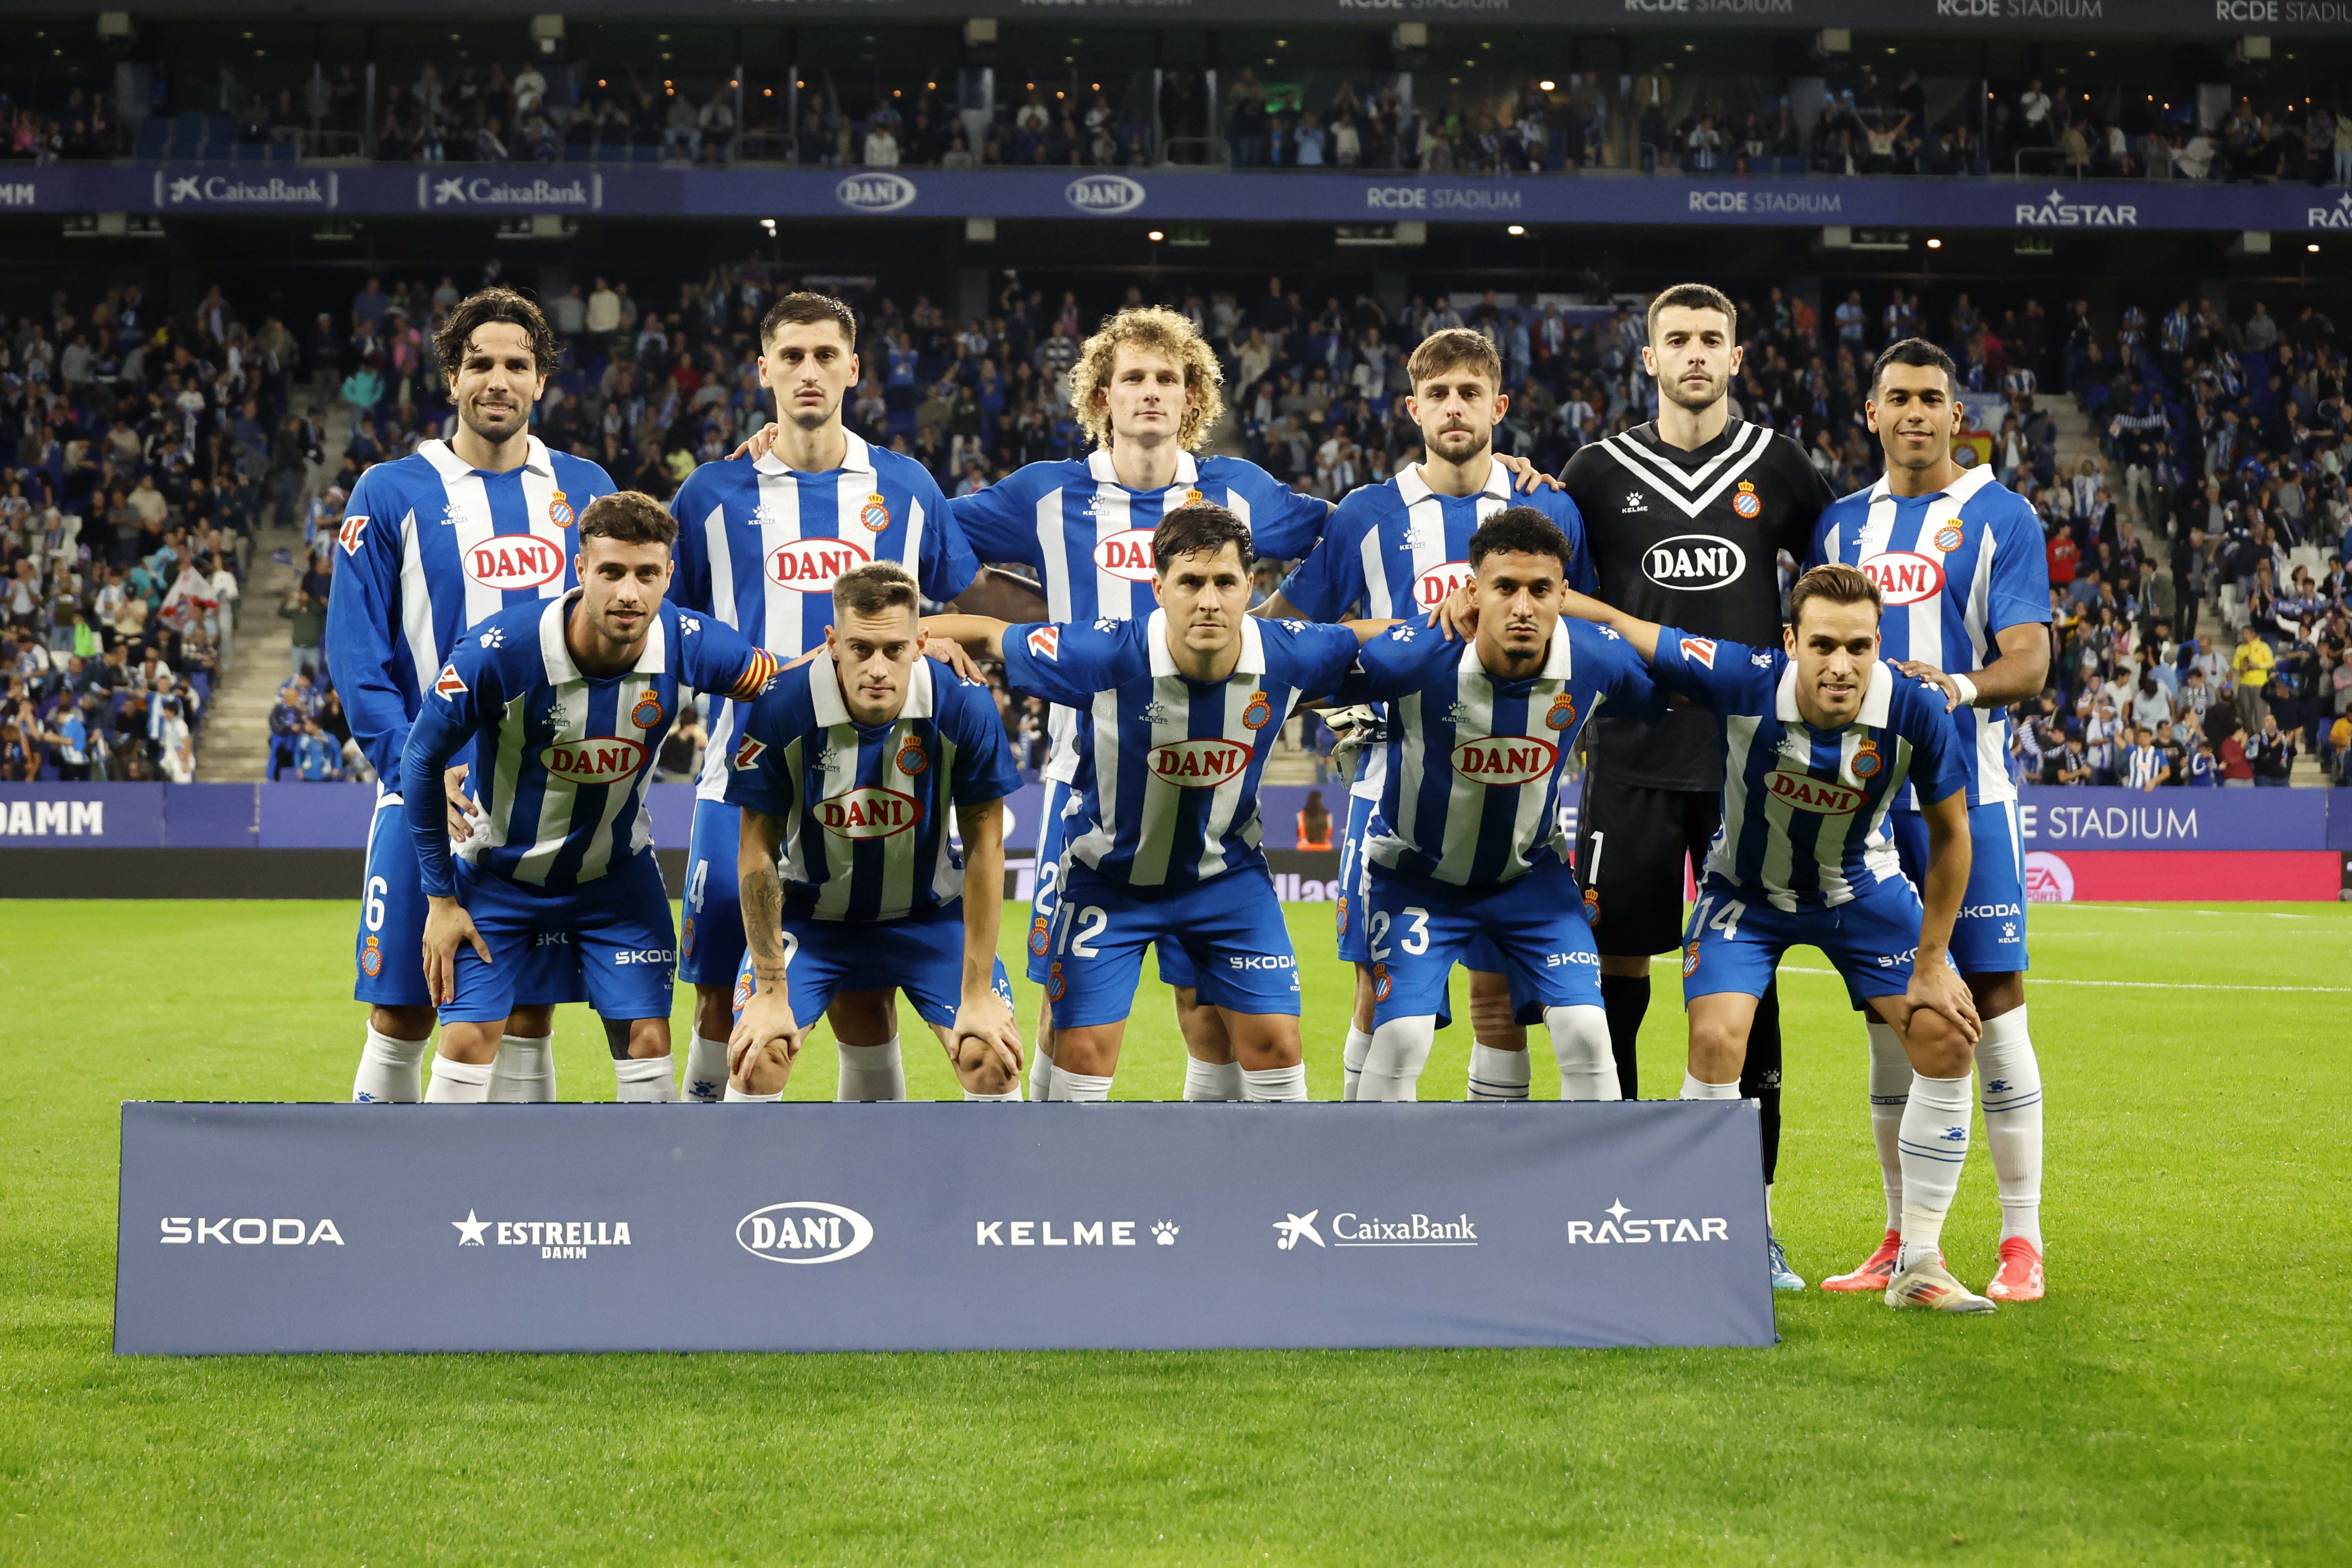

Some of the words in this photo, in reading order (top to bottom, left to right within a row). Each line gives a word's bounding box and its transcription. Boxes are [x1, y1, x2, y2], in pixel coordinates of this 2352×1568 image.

[1937, 0, 2000, 17] RCDE
[2007, 0, 2102, 17] STADIUM
[2216, 0, 2278, 21] RCDE
[204, 177, 322, 202] CaixaBank
[469, 178, 586, 204] CaixaBank
[846, 181, 898, 203] DANI
[1075, 184, 1128, 205] DANI
[1367, 188, 1426, 208] RCDE
[1432, 189, 1521, 210] STADIUM
[1689, 191, 1747, 212] RCDE
[1753, 192, 1842, 213] STADIUM
[2015, 205, 2137, 225] RASTAR
[2308, 207, 2352, 227] RA
[441, 516, 468, 525] KELME
[1400, 542, 1426, 551] KELME
[474, 546, 550, 578] DANI
[776, 550, 853, 580] DANI
[1652, 547, 1729, 579] DANI
[1139, 715, 1168, 725] KELME
[1442, 716, 1470, 724] KELME
[550, 747, 632, 774] DANI
[812, 764, 841, 773] KELME
[1156, 749, 1238, 777] DANI
[1461, 747, 1542, 774] DANI
[1771, 773, 1853, 810] DANI
[0, 801, 103, 835] AMM
[823, 799, 903, 829] DANI
[2049, 806, 2198, 839] STADIUM
[1590, 830, 1603, 885] 1
[689, 859, 708, 914] 4
[1035, 861, 1059, 916] 2
[365, 875, 388, 931] 6
[1057, 902, 1107, 958] 12
[1692, 896, 1747, 940] 14
[1546, 952, 1601, 967] SKOD
[160, 1217, 345, 1245] SKODA
[497, 1222, 631, 1245] ESTRELLA
[751, 1217, 842, 1249] DANI
[976, 1221, 1136, 1246] KELME
[1333, 1213, 1478, 1240] CaixaBank
[1567, 1217, 1730, 1244] RASTAR
[542, 1247, 587, 1259] DAMM
